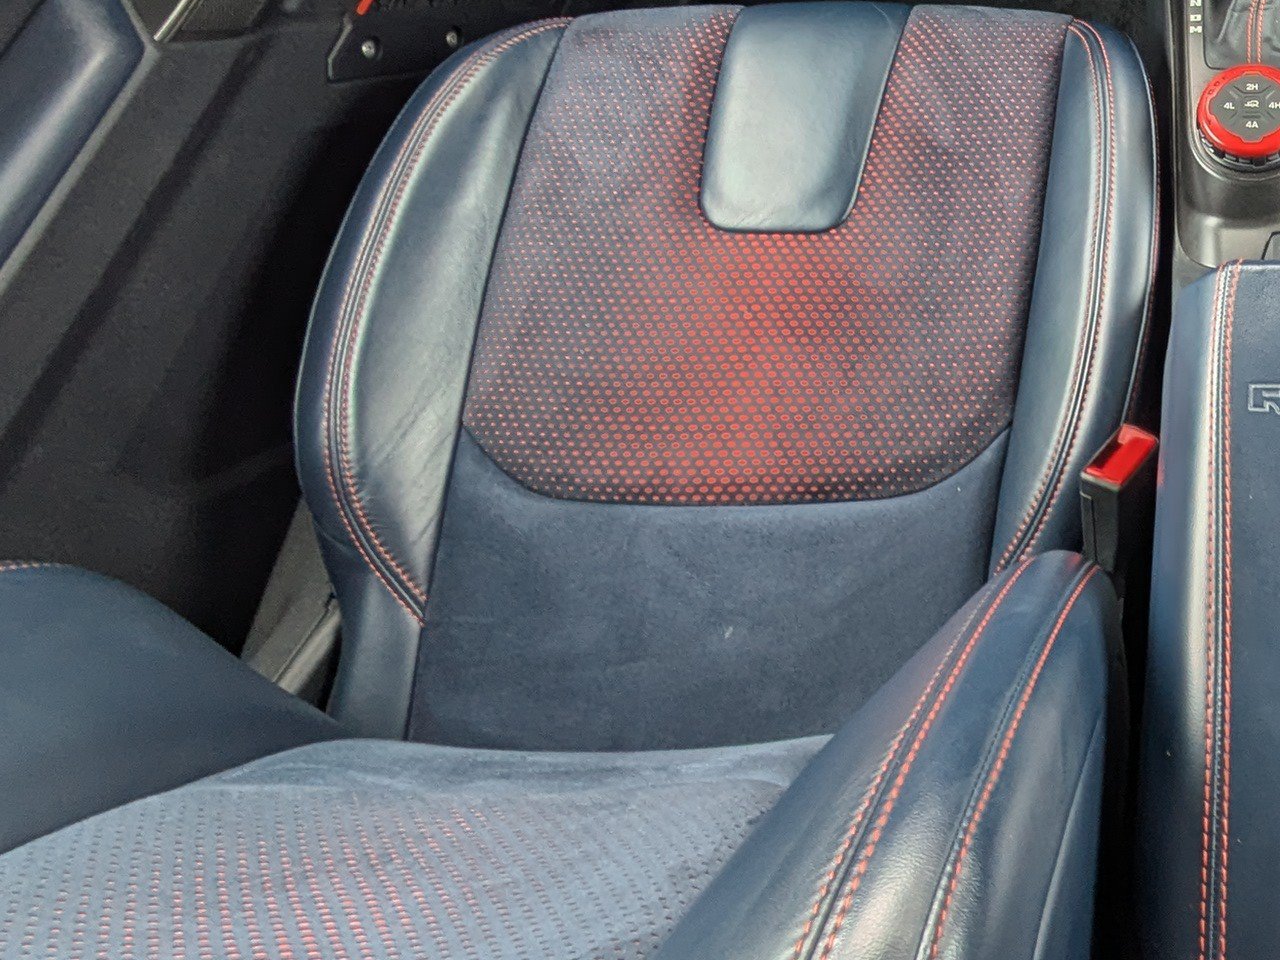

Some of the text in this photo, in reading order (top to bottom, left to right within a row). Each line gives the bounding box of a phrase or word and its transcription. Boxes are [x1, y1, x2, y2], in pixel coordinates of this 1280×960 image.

[1189, 0, 1202, 7] N
[1189, 25, 1203, 34] M
[1245, 83, 1259, 91] 2H
[1223, 101, 1235, 109] 4L
[1245, 120, 1259, 129] 4A
